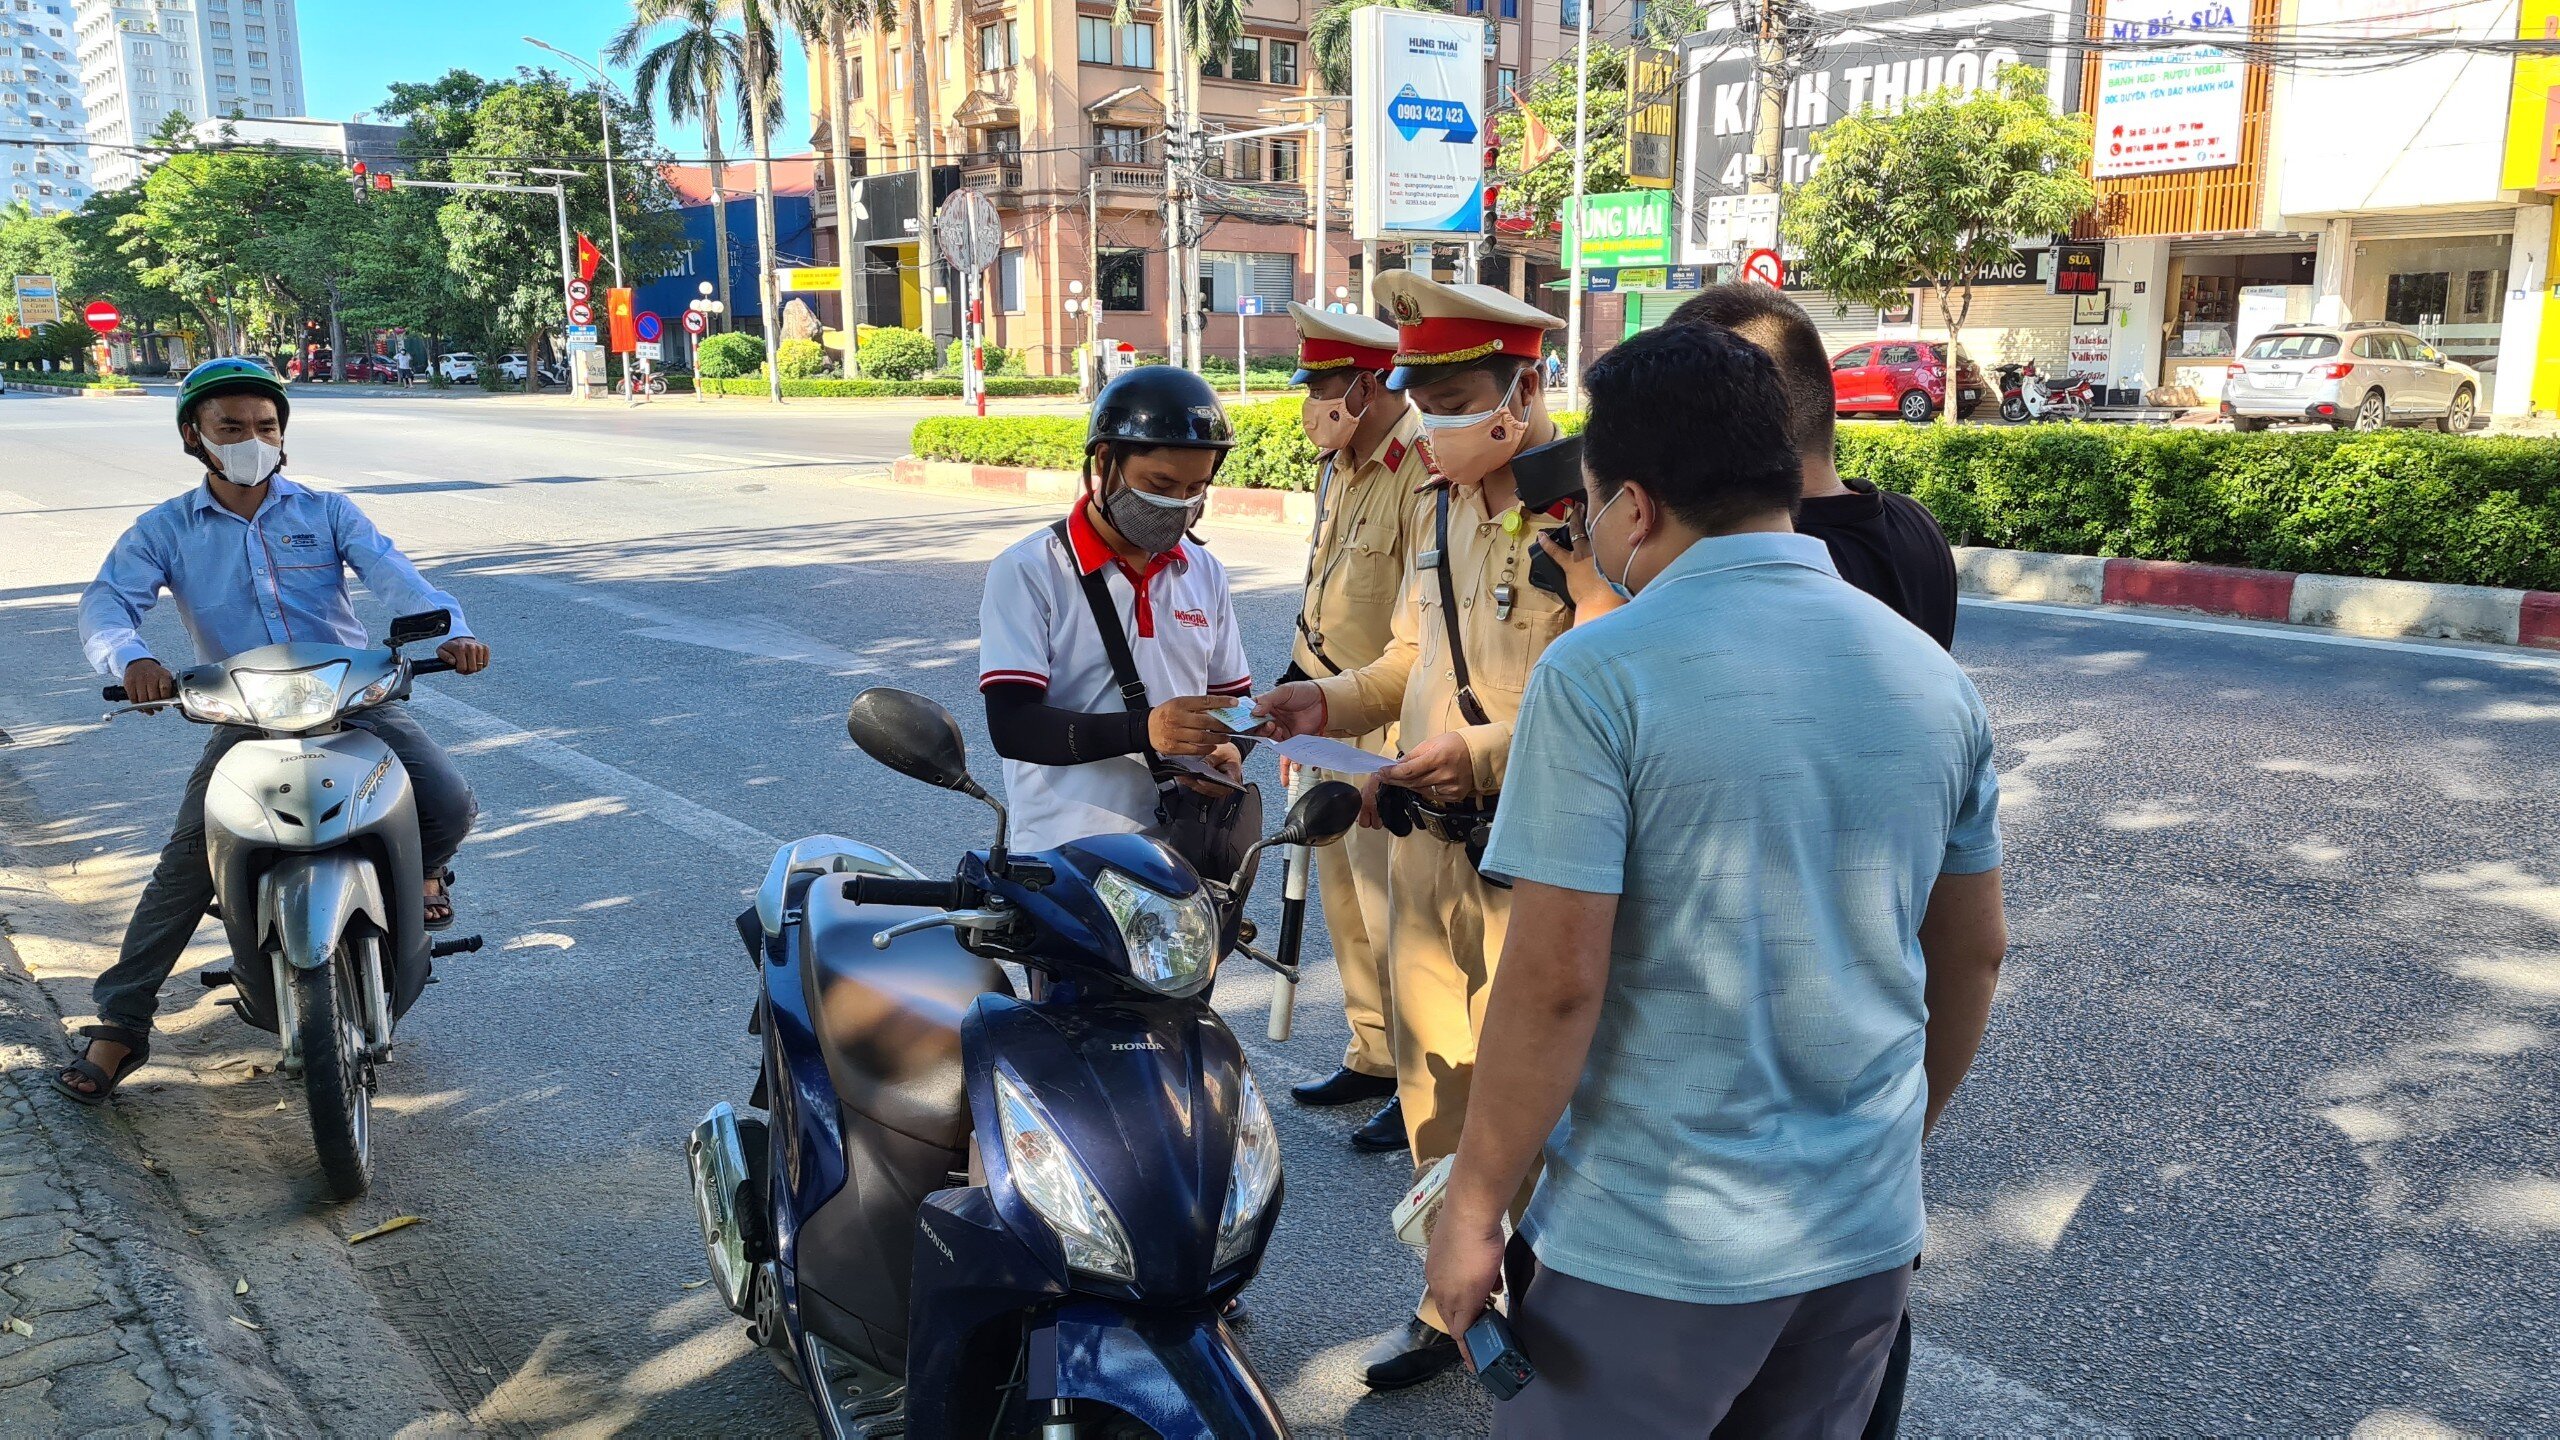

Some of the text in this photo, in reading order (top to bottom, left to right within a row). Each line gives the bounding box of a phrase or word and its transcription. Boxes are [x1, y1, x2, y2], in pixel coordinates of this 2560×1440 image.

[1397, 103, 1464, 124] 0903 423 423
[1627, 204, 1663, 237] MAI
[2068, 251, 2092, 266] SỮA
[1121, 355, 1132, 366] H4
[280, 753, 327, 763] HONDA
[1110, 1042, 1166, 1051] HONDA
[920, 1217, 955, 1263] HONDA
